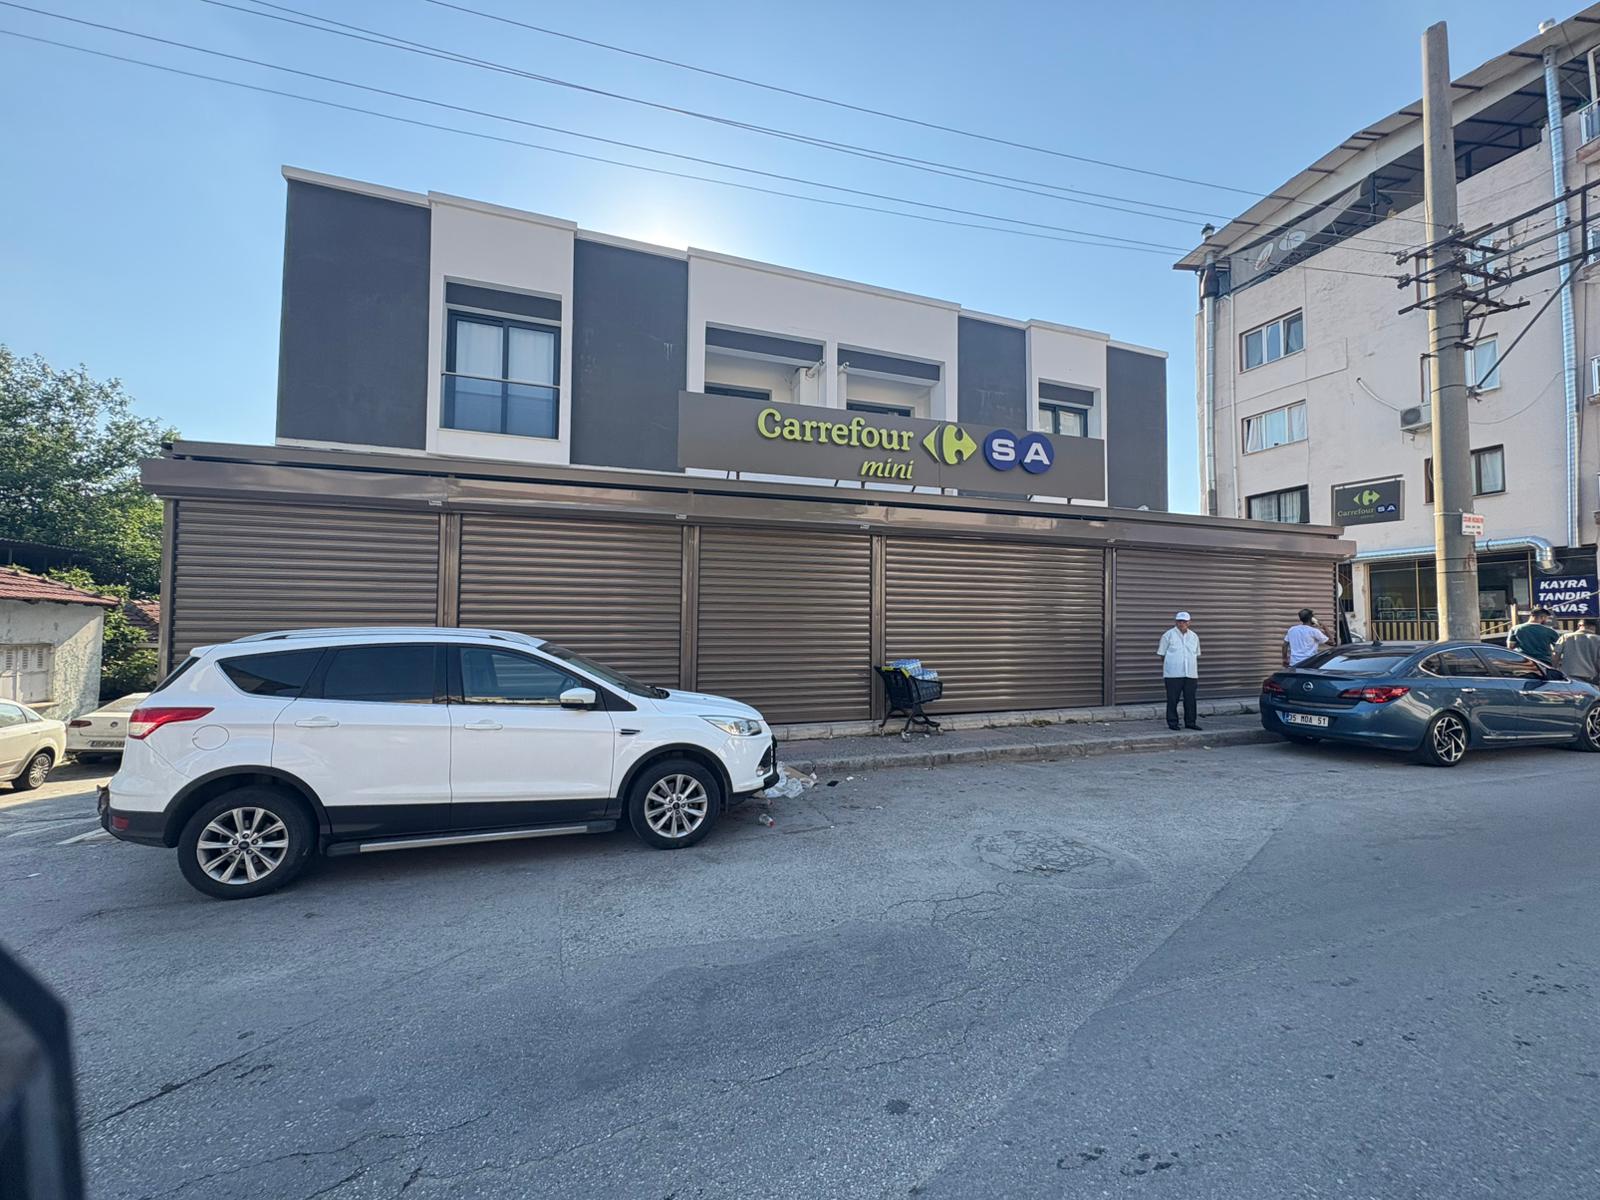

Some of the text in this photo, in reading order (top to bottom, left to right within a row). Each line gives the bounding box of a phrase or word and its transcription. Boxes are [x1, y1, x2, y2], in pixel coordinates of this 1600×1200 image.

[757, 408, 914, 451] Carrefour
[860, 458, 915, 480] mini
[1337, 508, 1374, 517] Carrefour
[1540, 579, 1588, 590] KAYRA
[1538, 591, 1591, 601] TANDIR
[1317, 717, 1326, 725] 51
